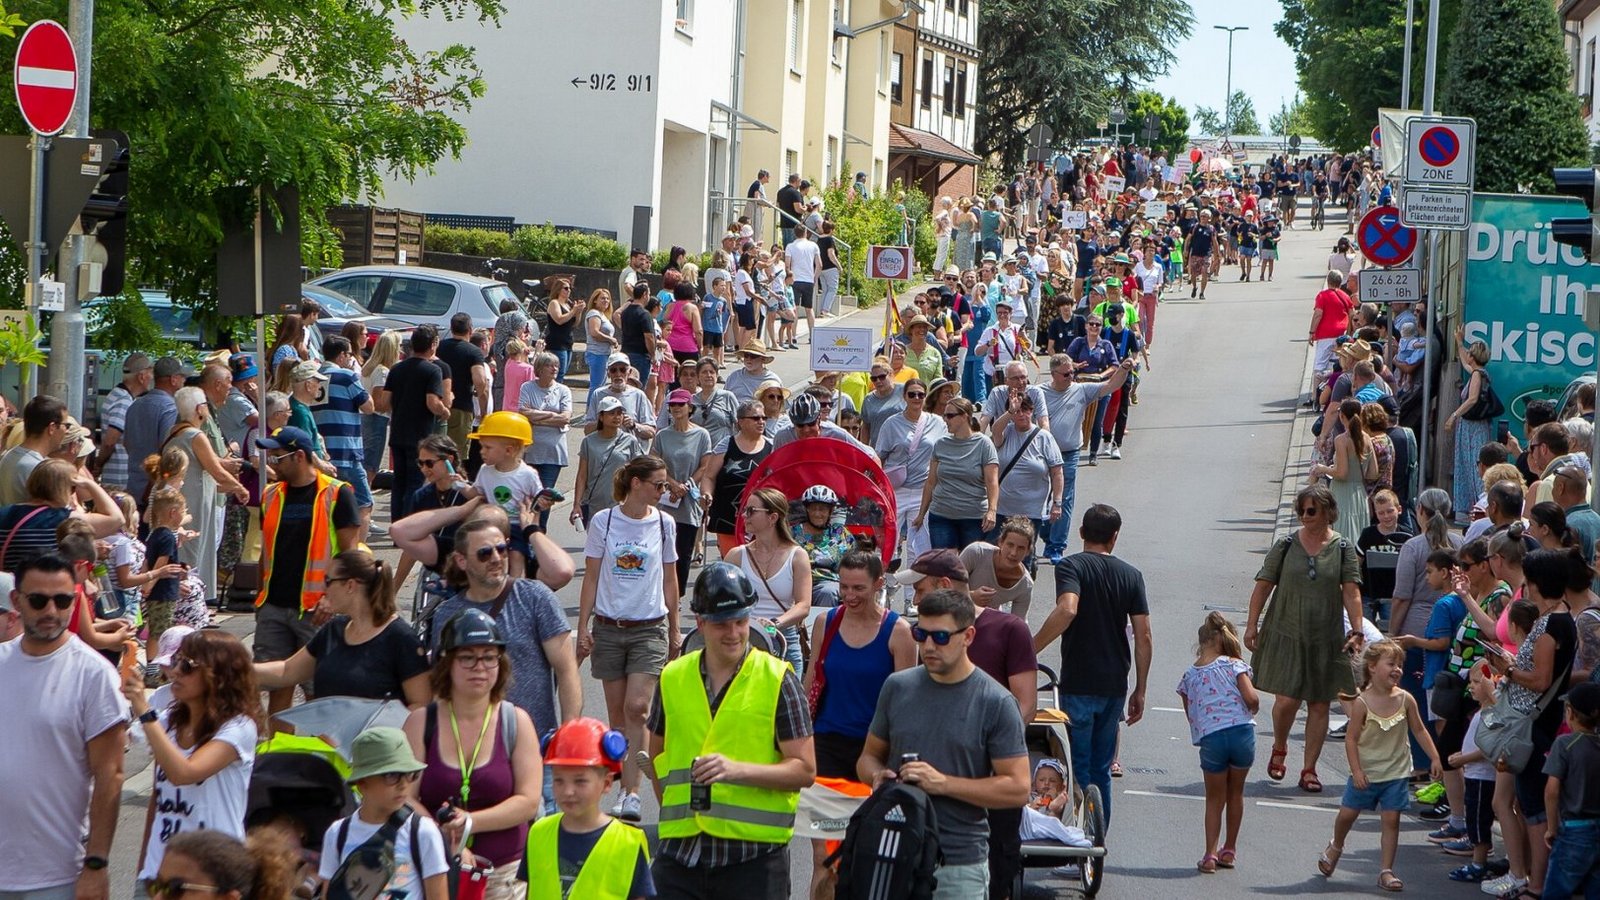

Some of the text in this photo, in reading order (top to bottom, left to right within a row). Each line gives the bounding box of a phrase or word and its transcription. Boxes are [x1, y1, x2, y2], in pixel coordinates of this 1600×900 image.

[590, 73, 652, 92] 9/2 9/1
[1422, 168, 1454, 180] ZONE
[1421, 194, 1452, 204] Parken in
[1407, 203, 1464, 213] gekennzeichneten
[1410, 211, 1460, 222] Flächen erlaubt
[1468, 221, 1600, 267] Drüc
[1371, 274, 1408, 285] 26.6.22
[1368, 288, 1378, 298] 10
[1395, 288, 1411, 297] 18h
[1539, 274, 1600, 315] Ih
